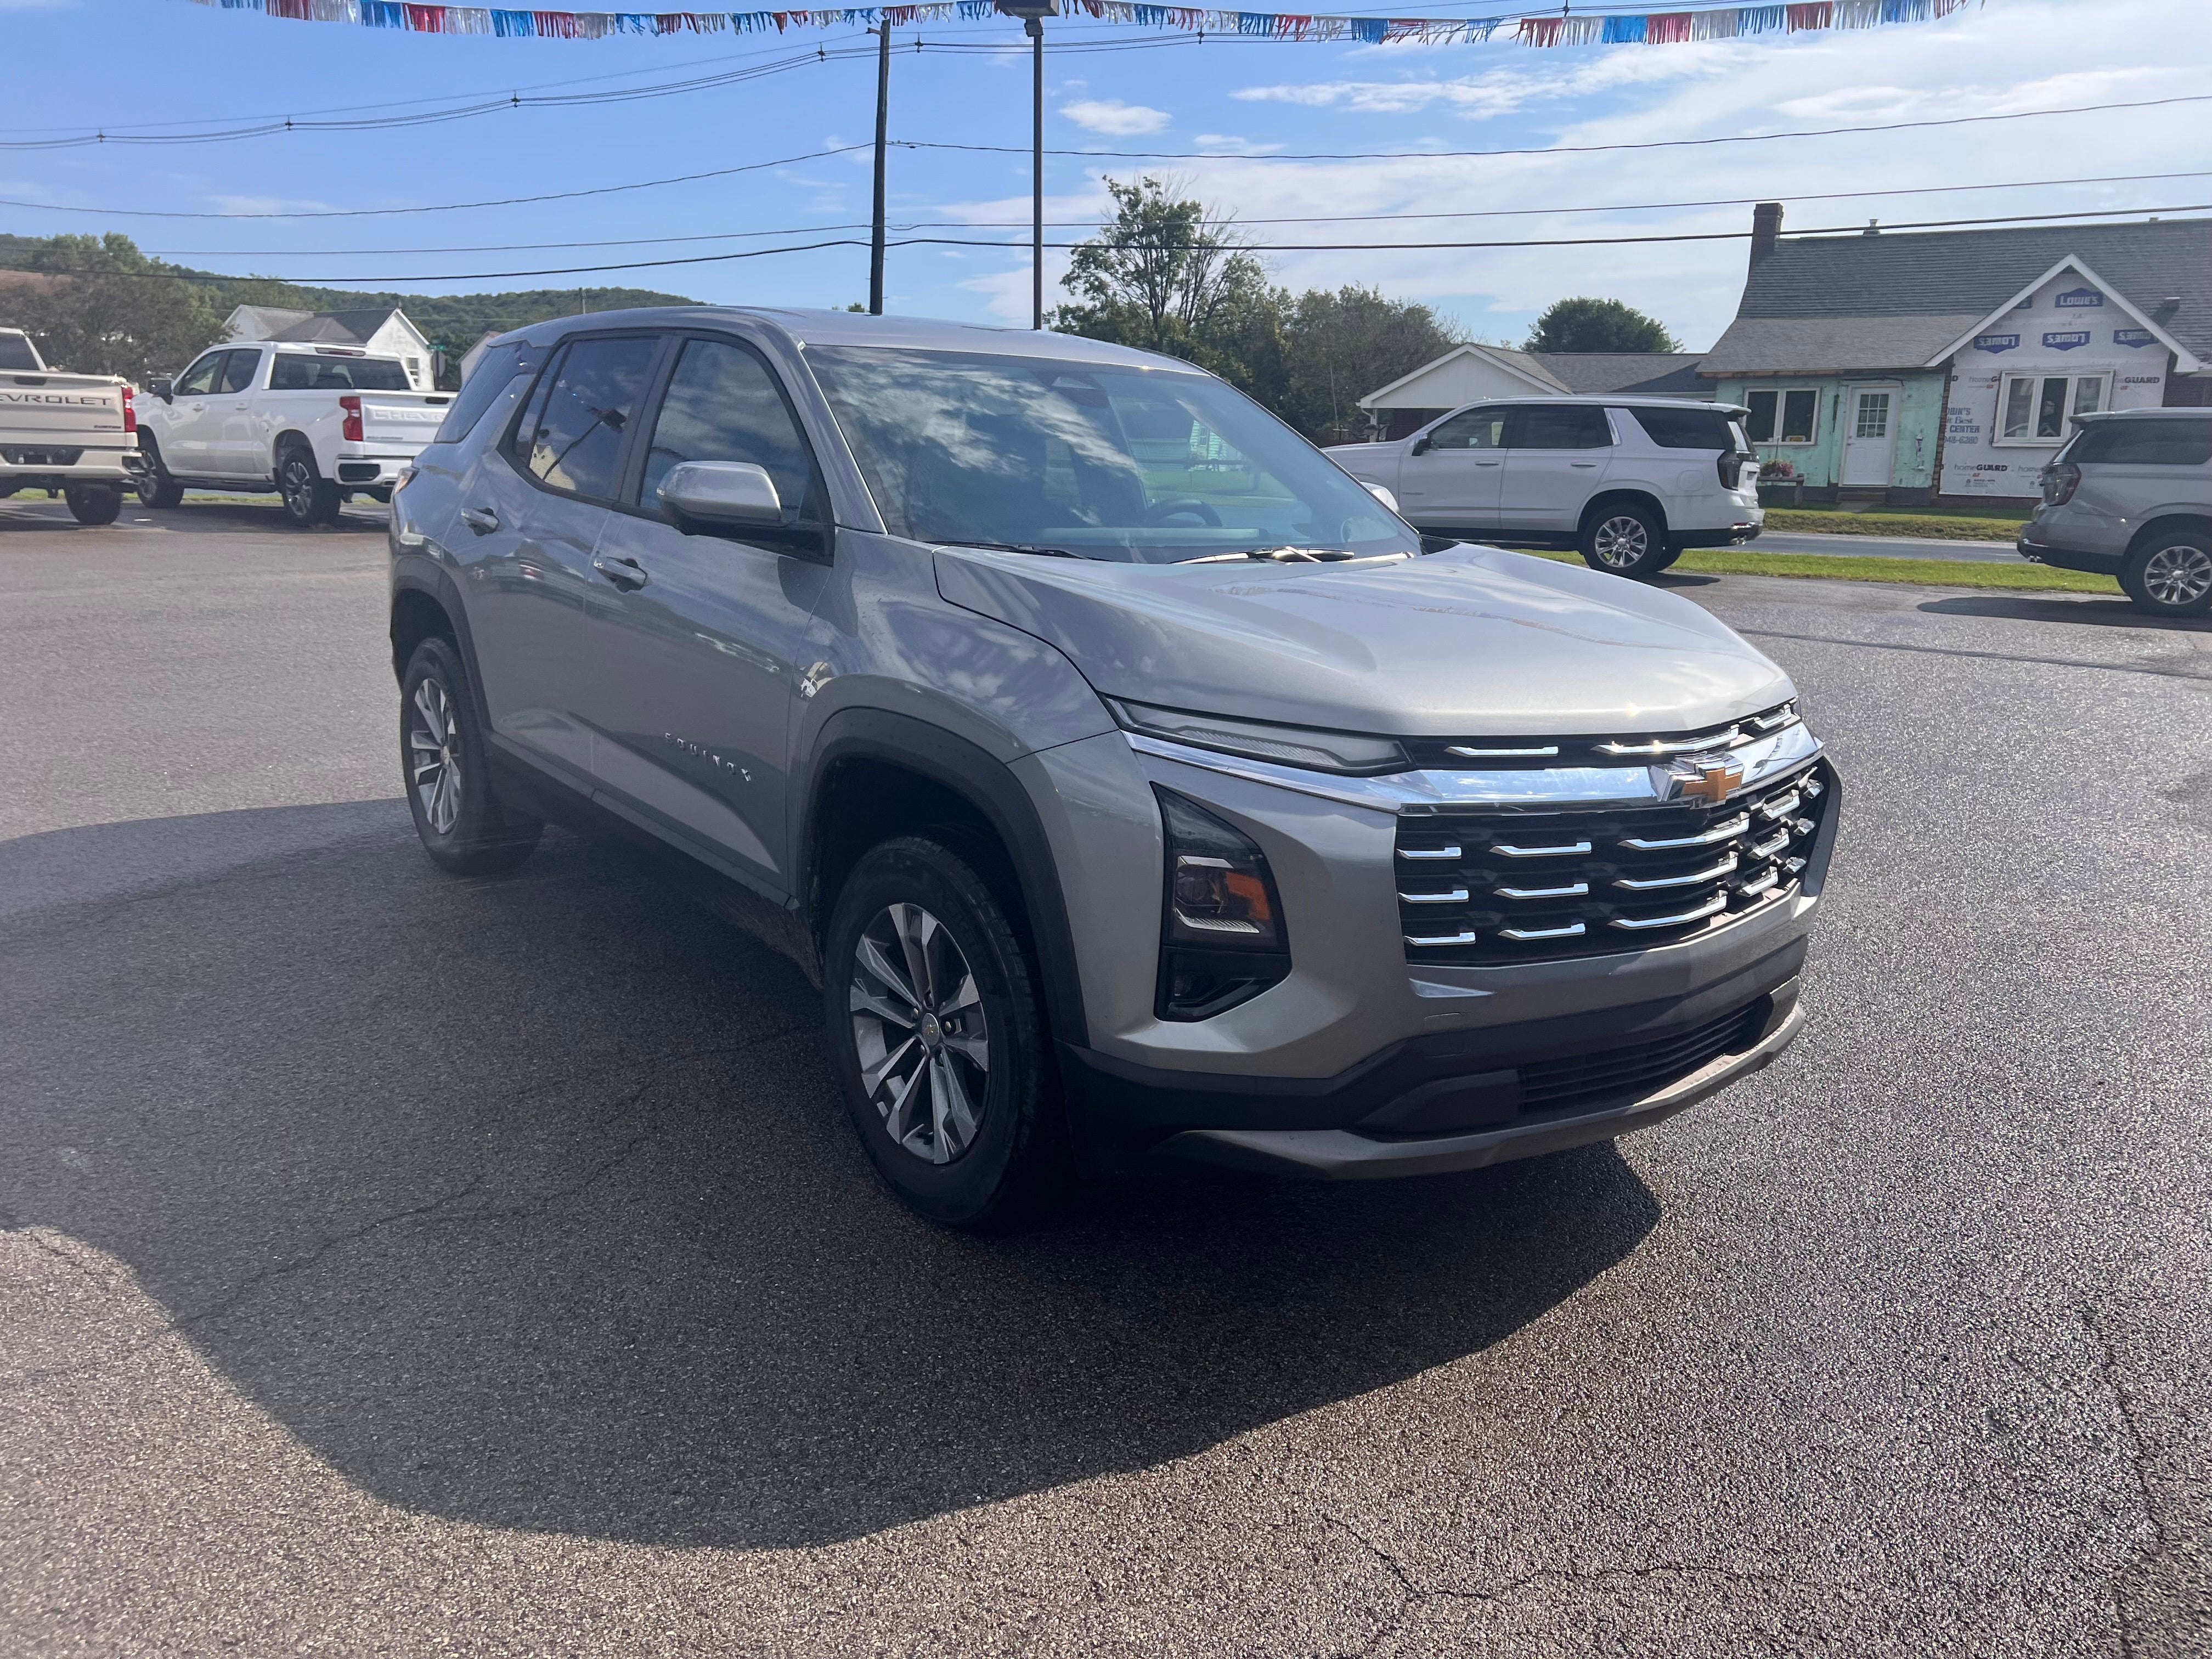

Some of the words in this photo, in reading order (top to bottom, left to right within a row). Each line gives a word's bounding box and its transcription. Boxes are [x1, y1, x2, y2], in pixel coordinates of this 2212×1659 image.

[0, 393, 111, 406] VROLET
[1950, 425, 1980, 433] CENTER
[665, 732, 752, 782] EQUINOX
